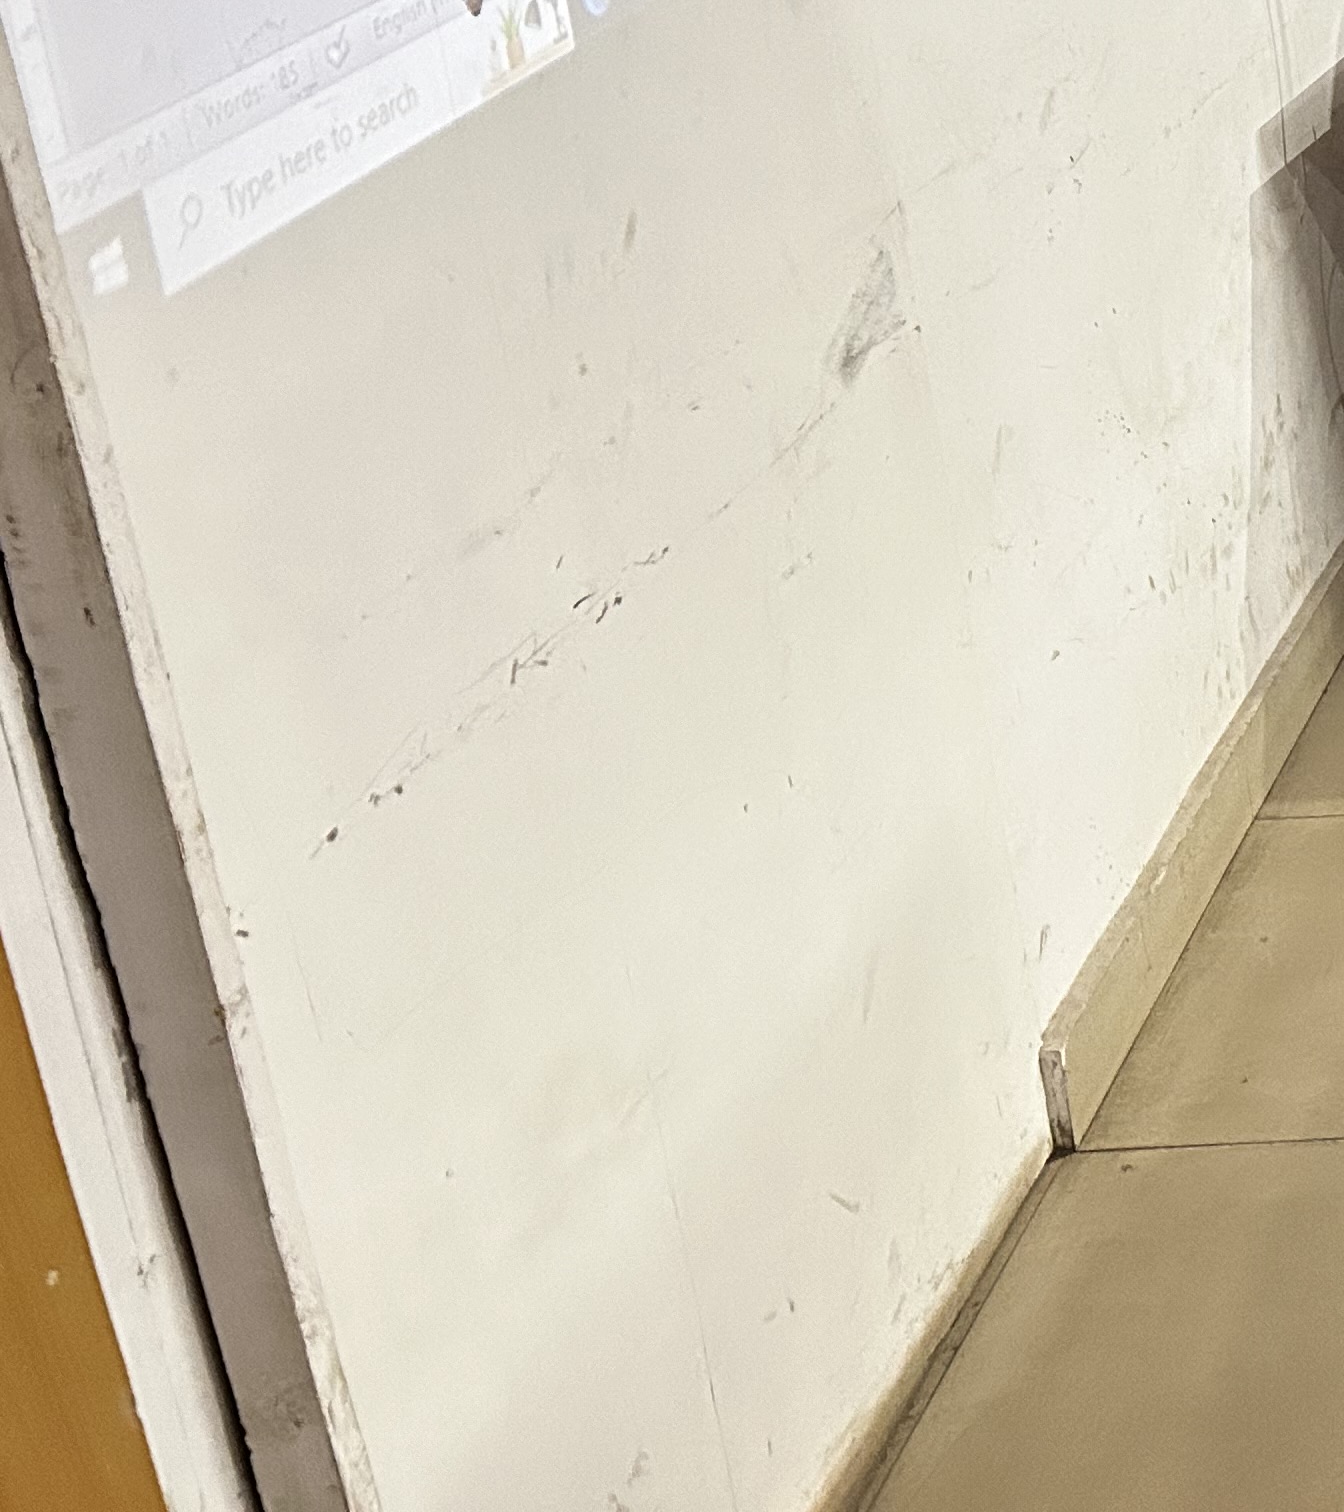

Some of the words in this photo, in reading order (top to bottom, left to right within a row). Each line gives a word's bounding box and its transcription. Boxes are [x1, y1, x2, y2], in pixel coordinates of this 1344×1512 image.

[220, 178, 276, 219] Type
[277, 136, 328, 184] here
[329, 116, 354, 153] to
[356, 82, 420, 137] search
